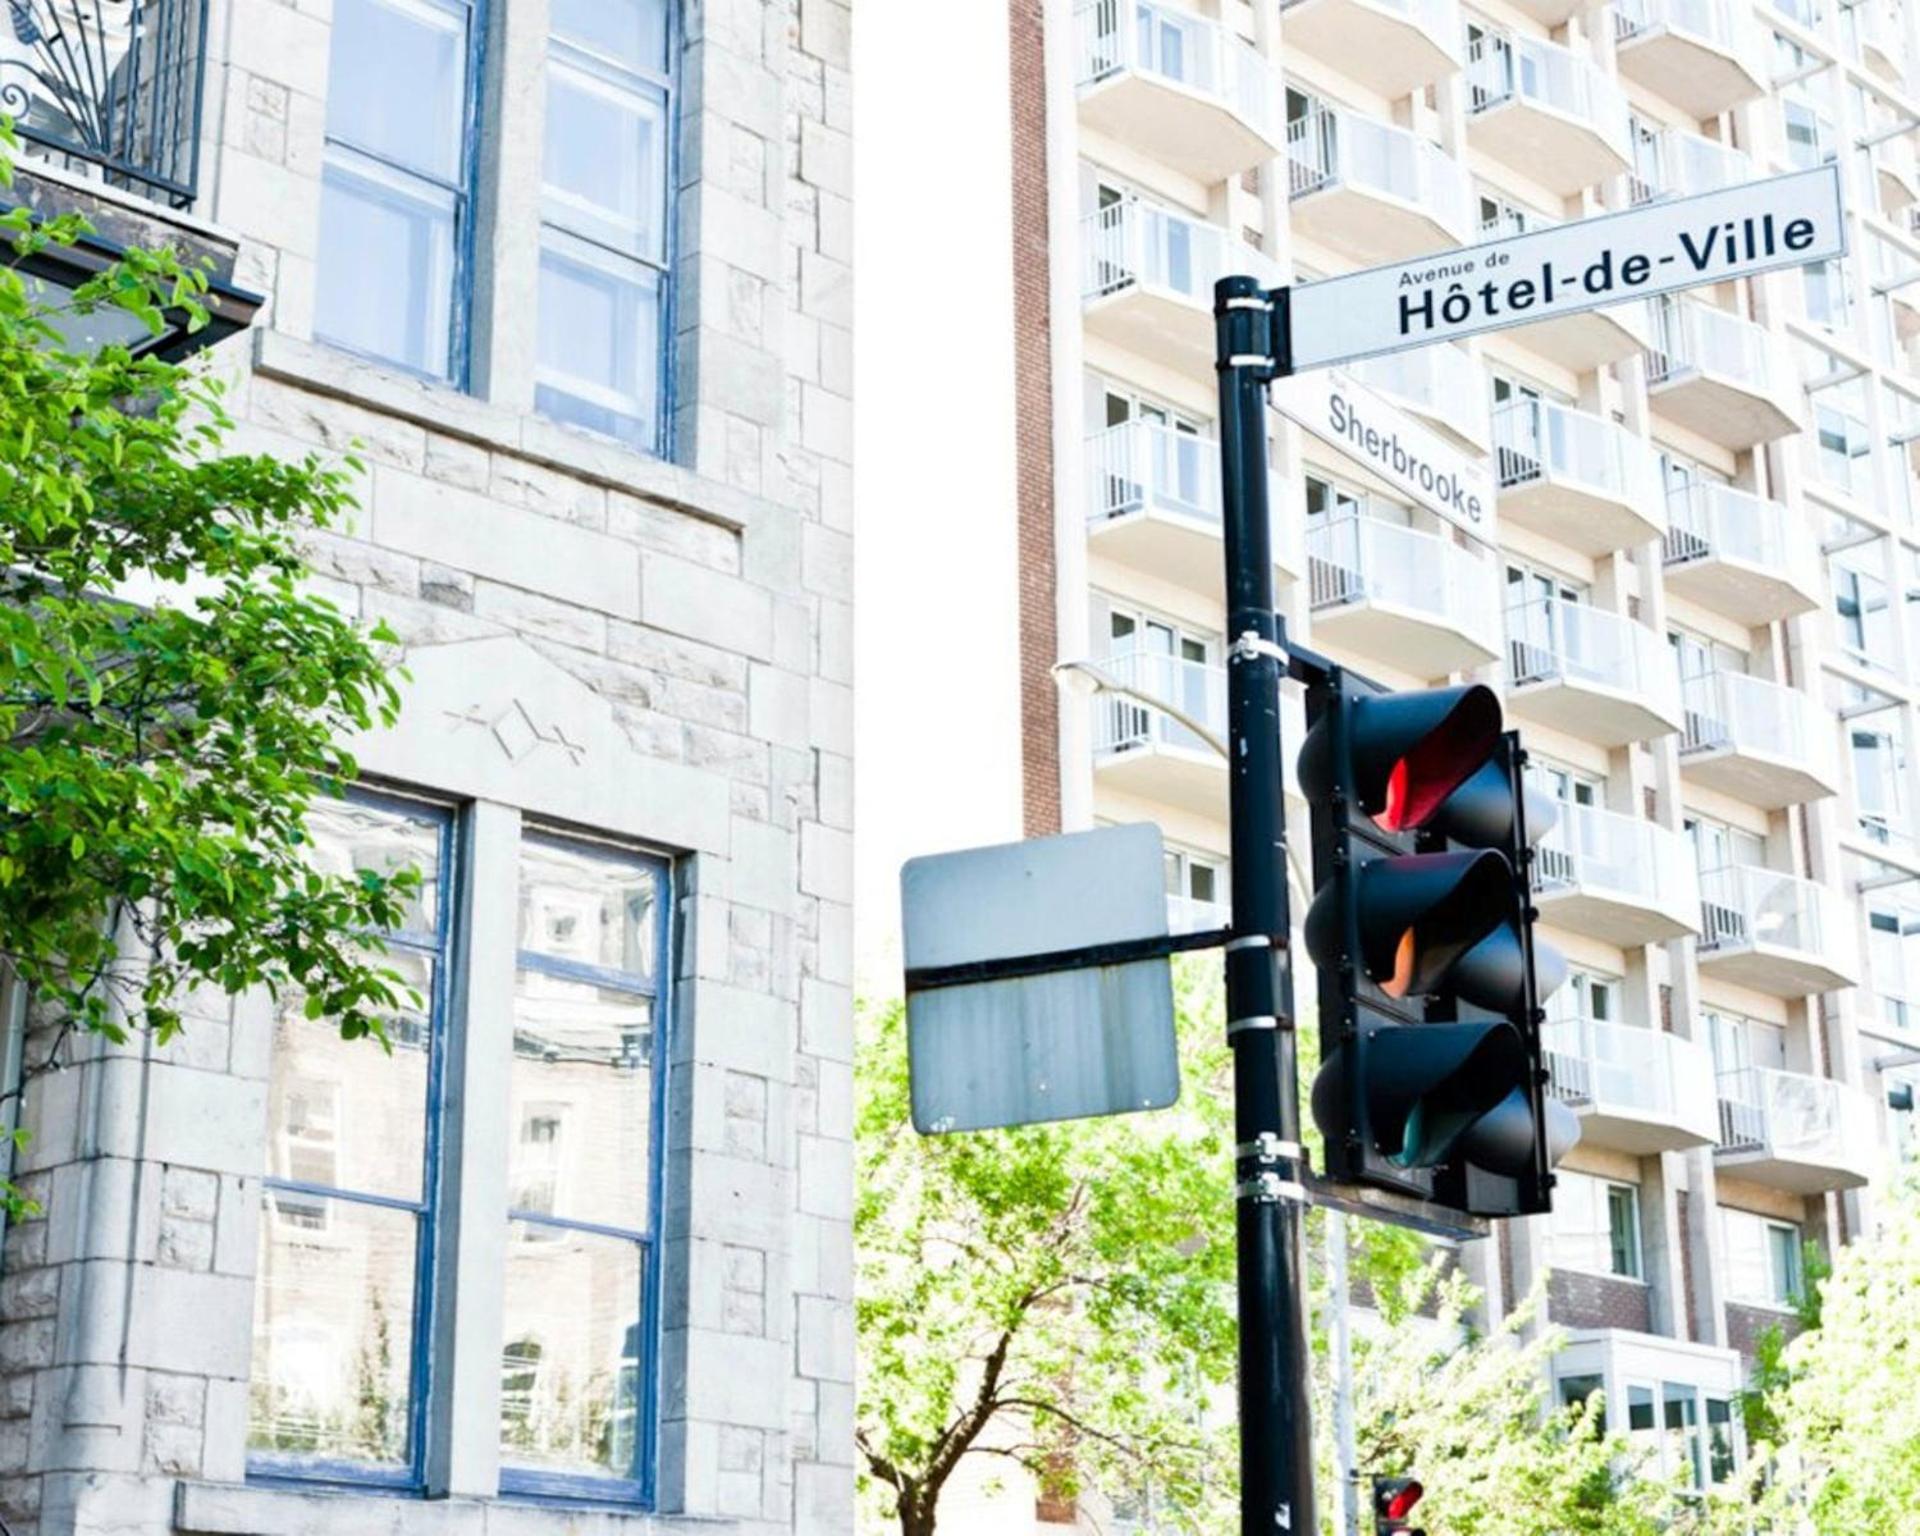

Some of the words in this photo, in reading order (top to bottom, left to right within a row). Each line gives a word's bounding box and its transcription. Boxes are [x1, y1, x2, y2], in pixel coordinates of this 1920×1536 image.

[1399, 213, 1815, 334] Hôtel-de-Ville
[1400, 261, 1474, 287] Avenue
[1485, 251, 1511, 268] de
[1329, 394, 1481, 523] Sherbrooke
